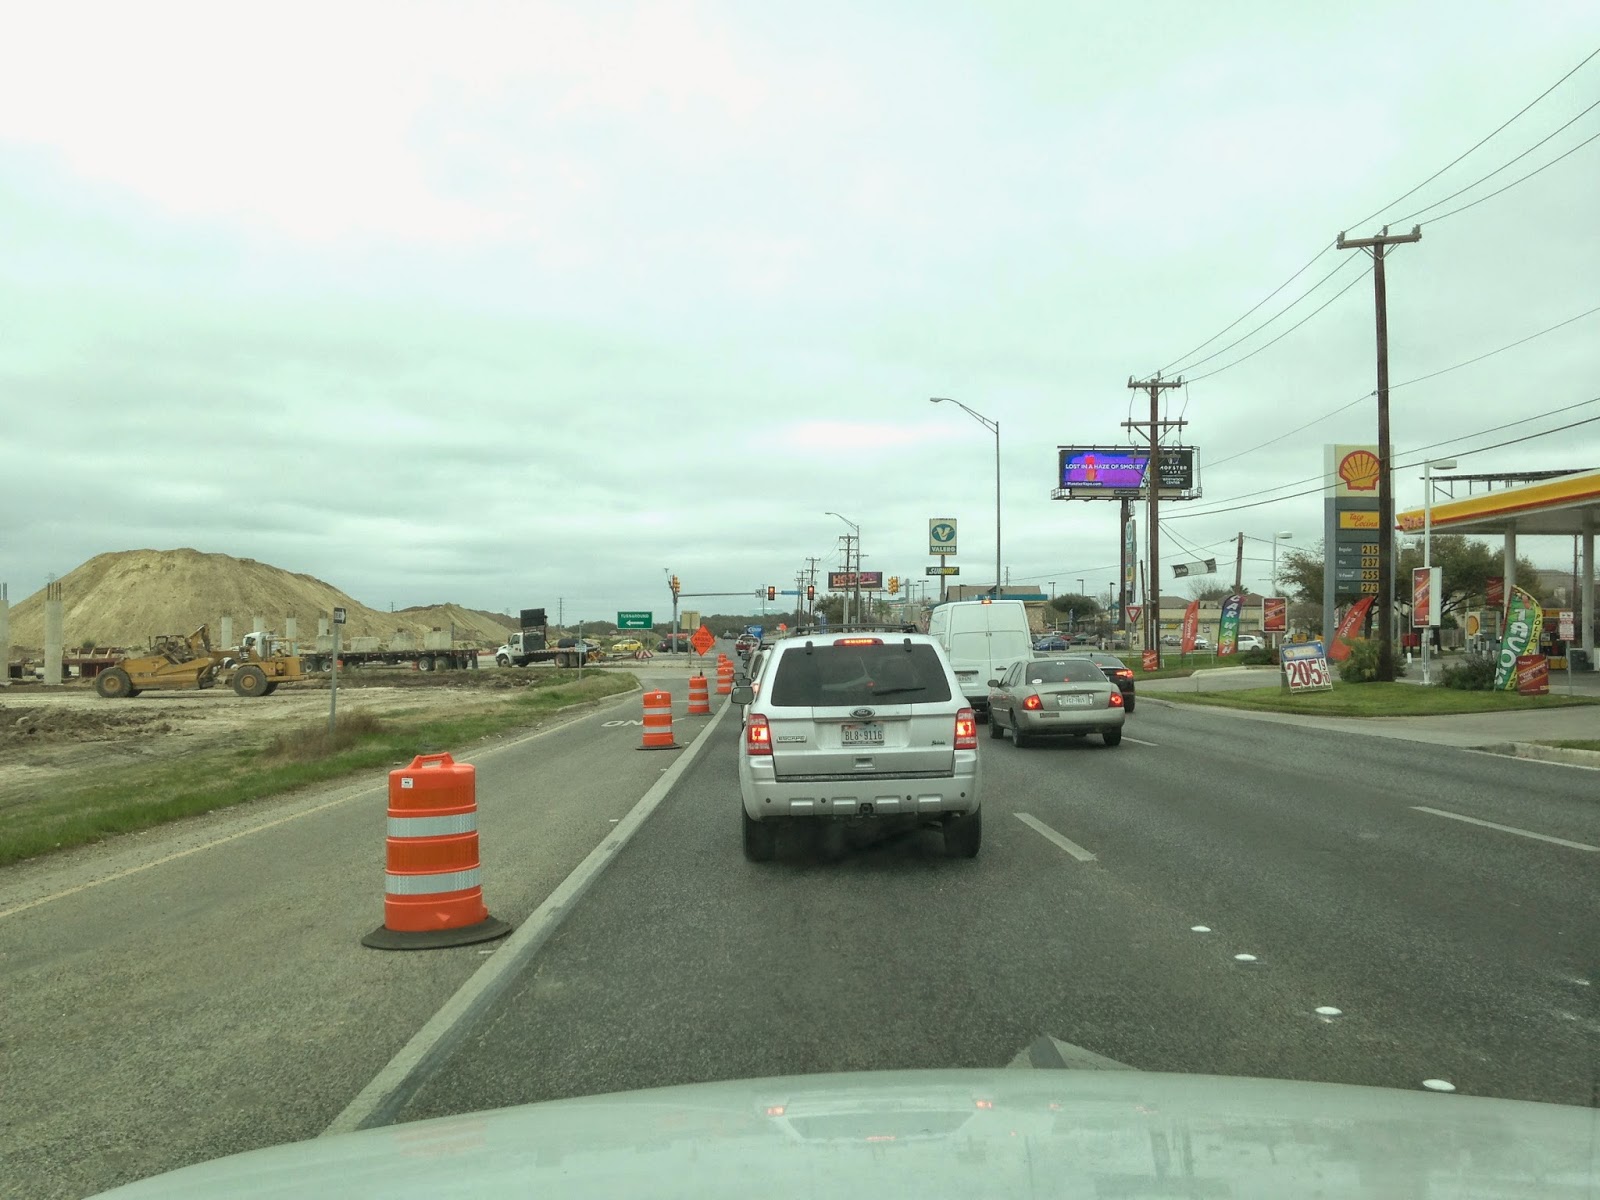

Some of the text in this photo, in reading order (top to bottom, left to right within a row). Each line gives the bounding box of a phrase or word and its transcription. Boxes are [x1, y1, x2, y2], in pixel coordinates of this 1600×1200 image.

[1350, 513, 1364, 521] Taco
[1362, 546, 1378, 554] 215
[1362, 559, 1378, 567] 237
[929, 567, 957, 575] SUBWAY
[1362, 571, 1378, 580] 255
[1362, 584, 1378, 592] 273
[1226, 594, 1241, 618] CAR
[1531, 613, 1541, 644] POLLO
[1221, 622, 1237, 655] WASH
[1287, 660, 1322, 686] 205
